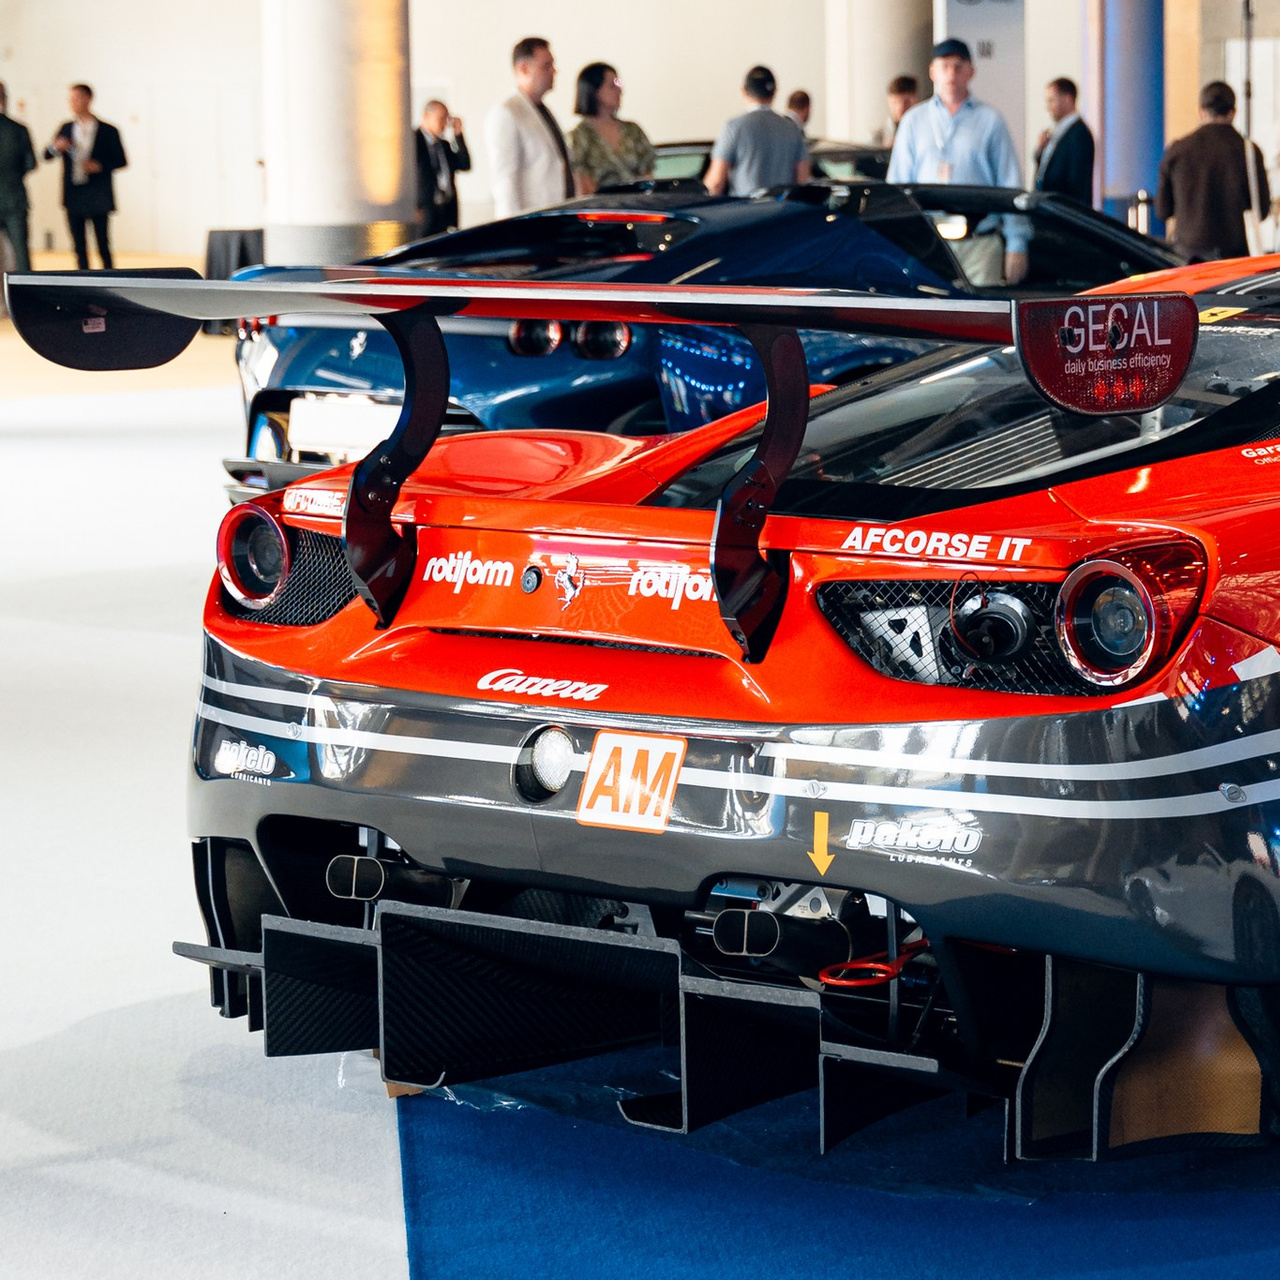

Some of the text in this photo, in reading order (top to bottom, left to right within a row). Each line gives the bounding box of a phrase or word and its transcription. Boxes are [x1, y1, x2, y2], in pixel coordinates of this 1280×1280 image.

[1064, 301, 1172, 353] GECAL
[1065, 353, 1172, 376] daily business efficiency
[841, 526, 1033, 561] AFCORSE IT
[422, 550, 514, 594] rotiform
[627, 565, 718, 610] rotifor
[477, 669, 609, 701] Carrera
[230, 771, 271, 786] LUBRICANTS
[585, 746, 677, 818] AM
